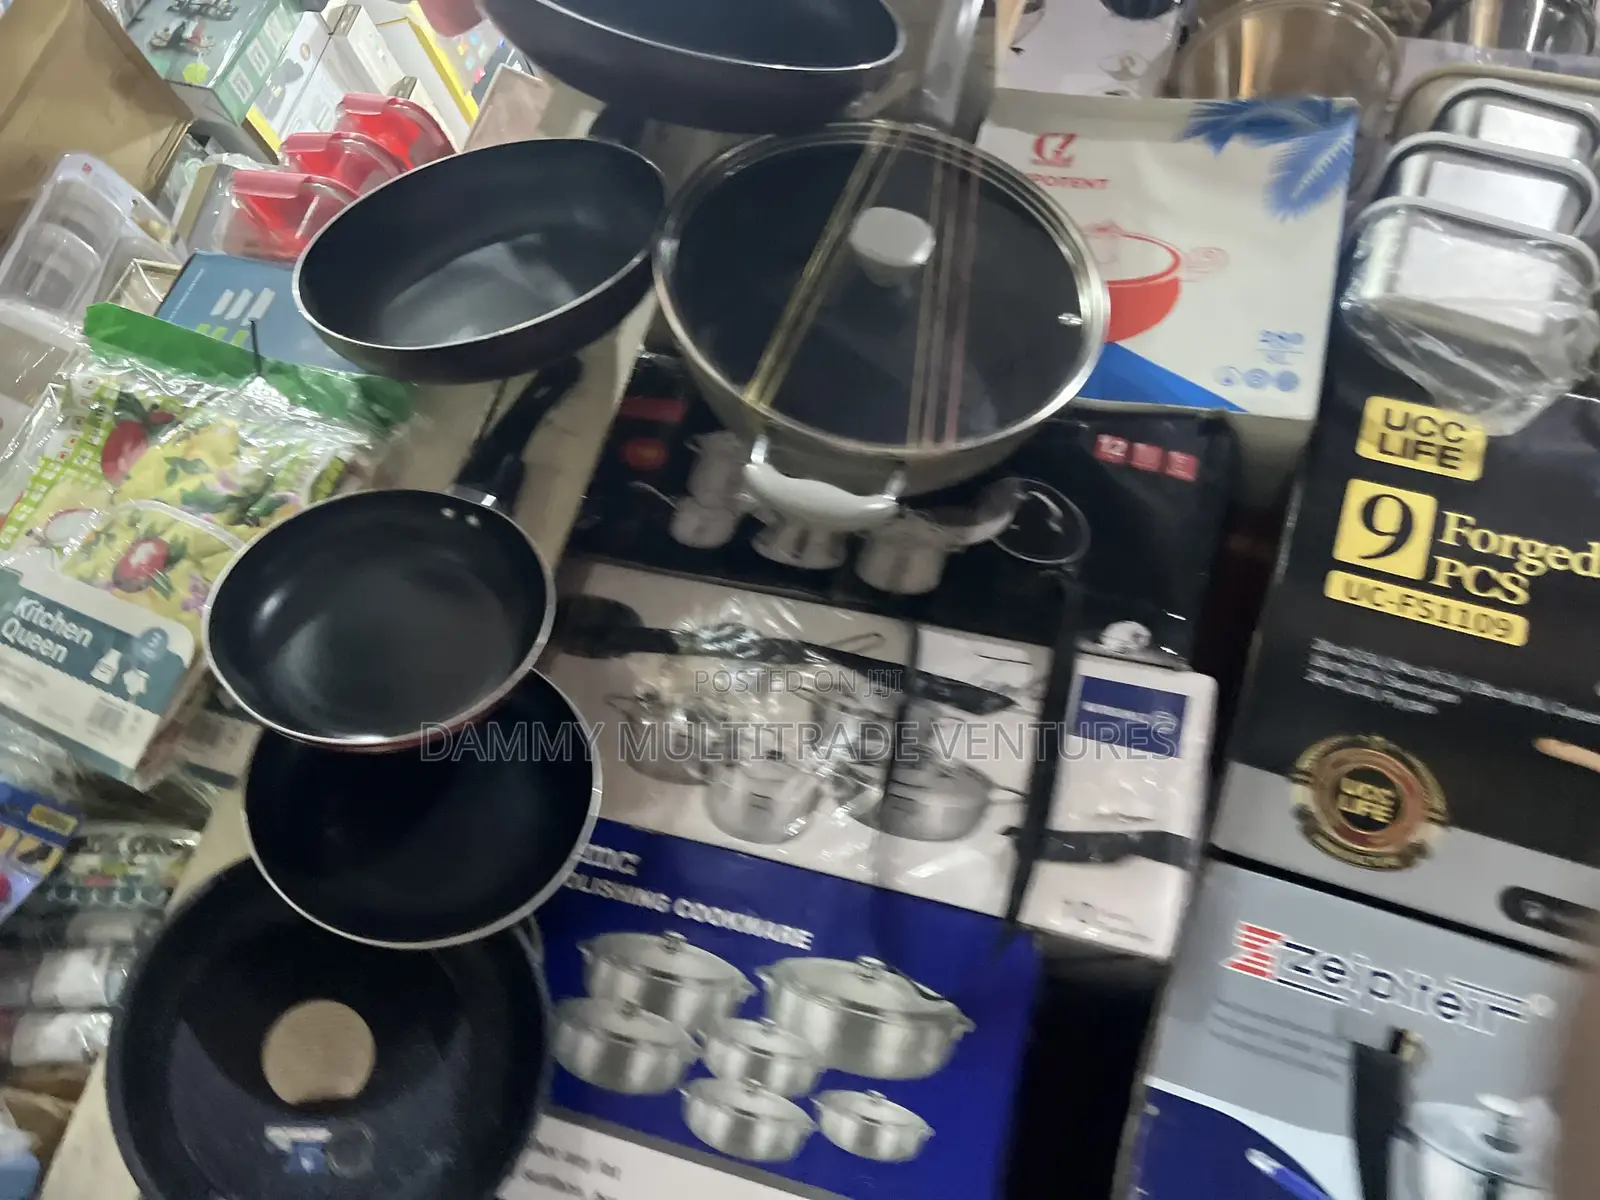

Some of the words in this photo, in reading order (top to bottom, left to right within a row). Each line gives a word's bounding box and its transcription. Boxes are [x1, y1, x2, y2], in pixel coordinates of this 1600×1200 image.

[1383, 407, 1467, 444] UCC
[1377, 432, 1462, 471] LIFE
[1358, 493, 1416, 561] 9
[1438, 510, 1600, 578] Forged
[1429, 555, 1531, 606] PCS
[13, 596, 94, 648] Kitchen
[1342, 577, 1516, 640] UC-FS1109
[1, 617, 69, 664] Queen
